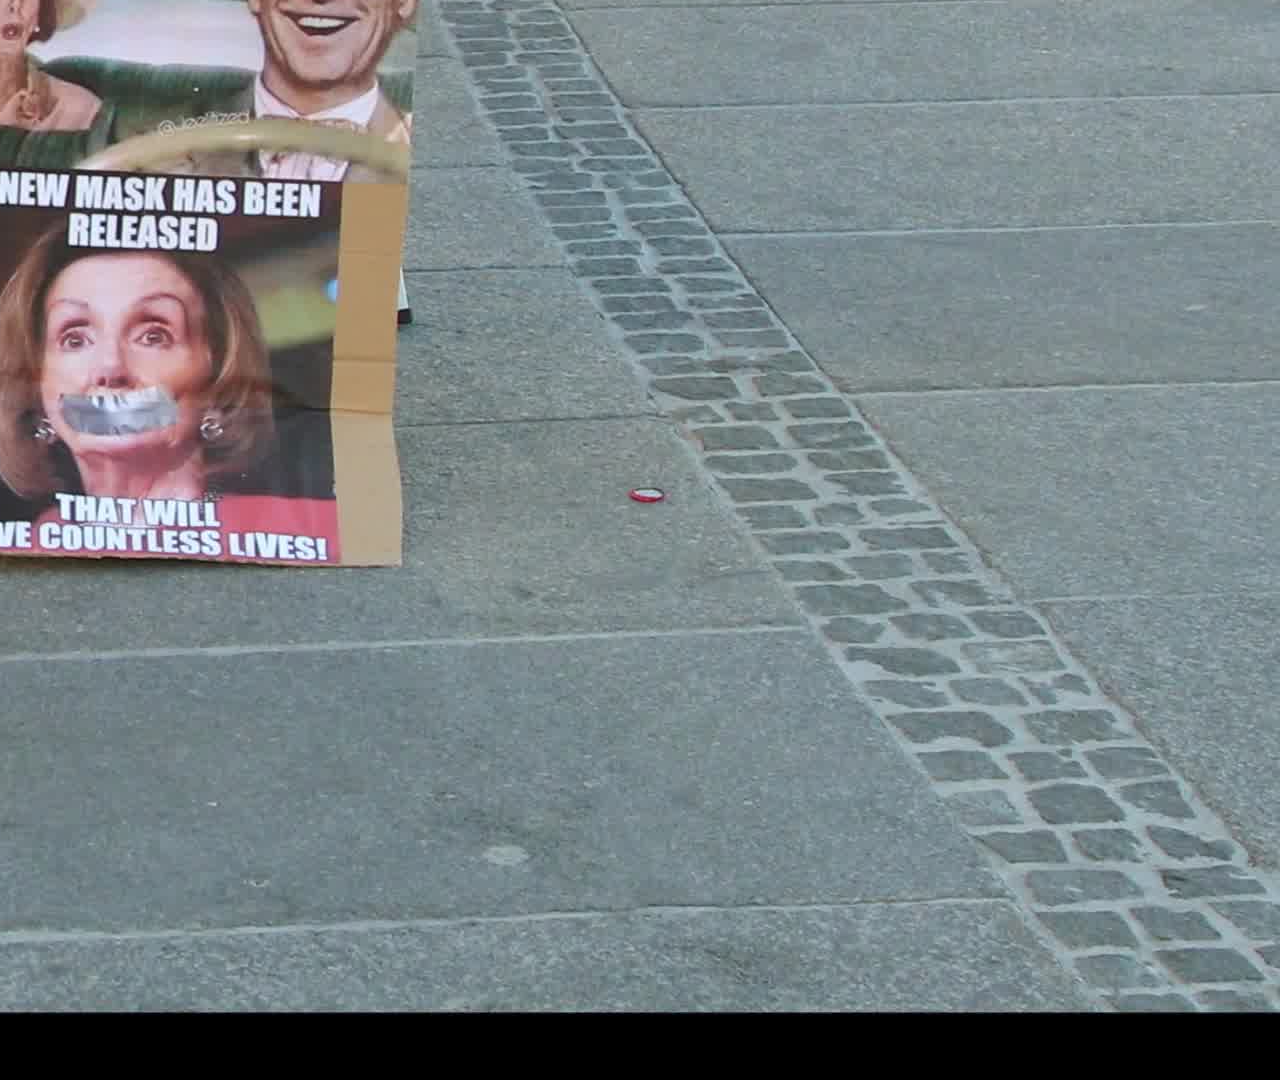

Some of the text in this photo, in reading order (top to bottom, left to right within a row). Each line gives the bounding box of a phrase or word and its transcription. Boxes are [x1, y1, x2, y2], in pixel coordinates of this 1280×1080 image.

[75, 174, 168, 214] MASK
[172, 178, 237, 215] HAS
[243, 180, 322, 218] BEEN
[67, 215, 220, 252] RELEASED
[56, 491, 221, 528] THAT WILL
[39, 521, 222, 557] COUNTLESS
[228, 530, 329, 561] LIVES!
